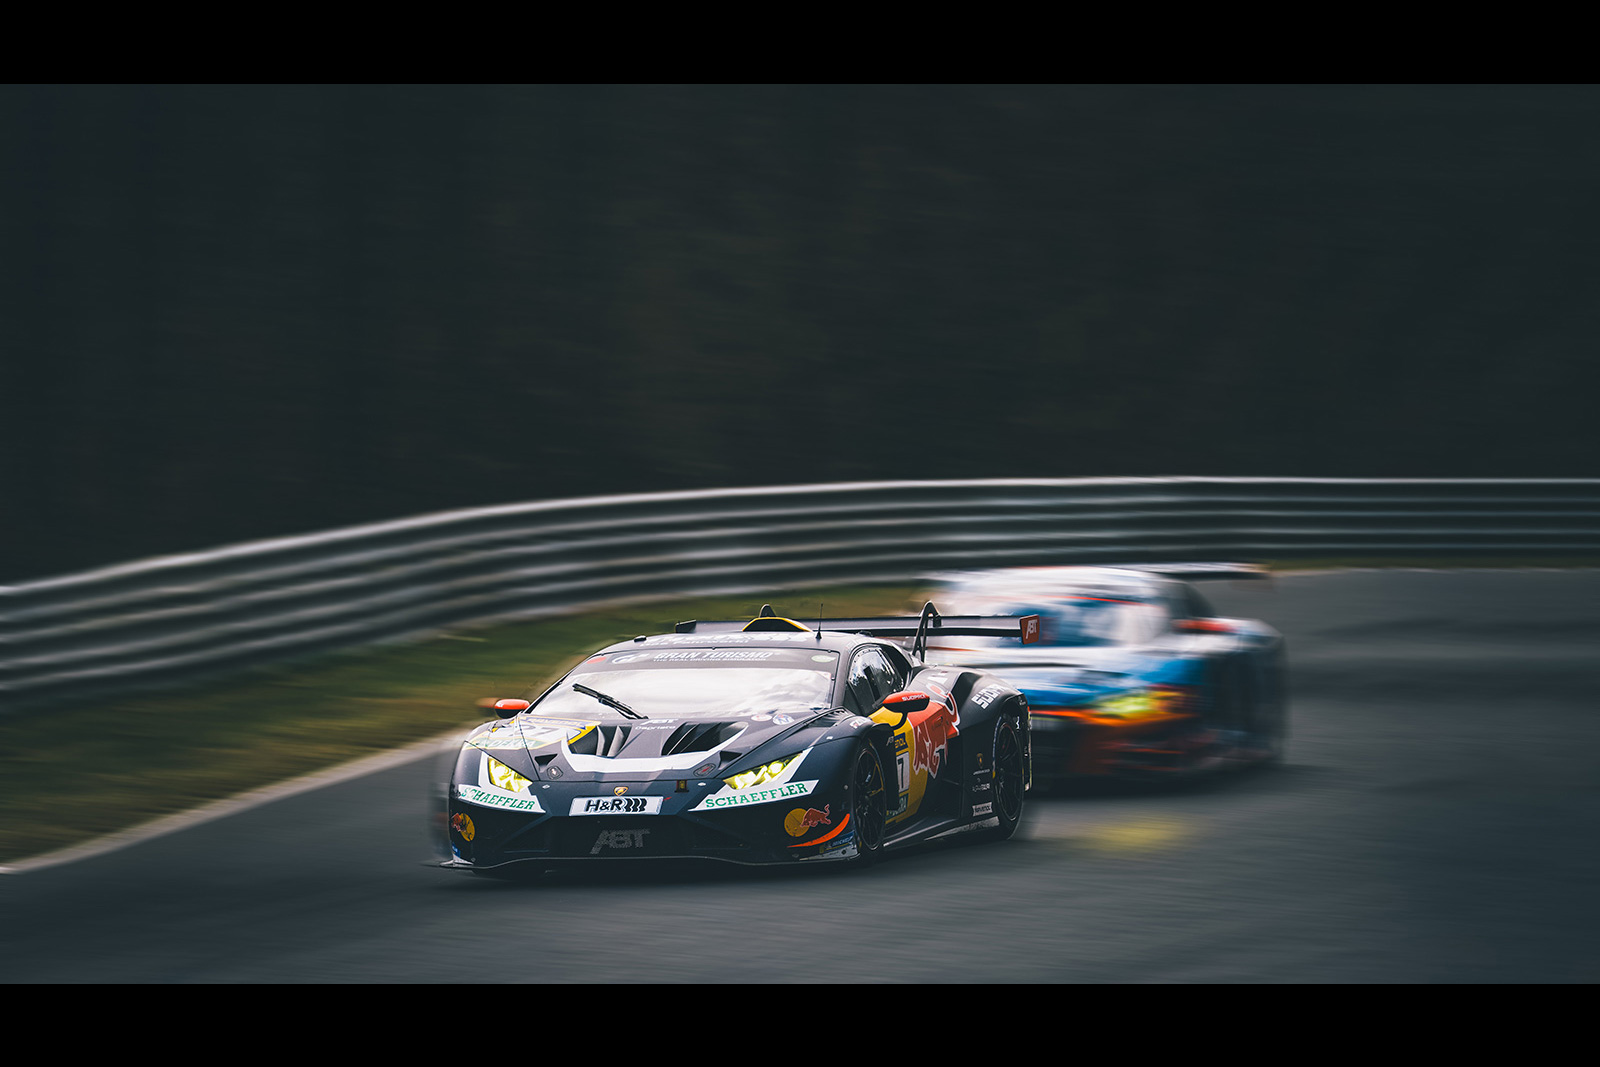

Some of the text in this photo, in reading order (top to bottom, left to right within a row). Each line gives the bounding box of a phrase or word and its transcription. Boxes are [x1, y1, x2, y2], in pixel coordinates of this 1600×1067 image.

[1025, 619, 1038, 639] ABT
[703, 651, 774, 659] TURISMO
[461, 787, 535, 810] SCHAEFFLER
[585, 799, 624, 812] H&R
[705, 783, 808, 808] SCHAEFFLER
[590, 828, 650, 854] ABT
